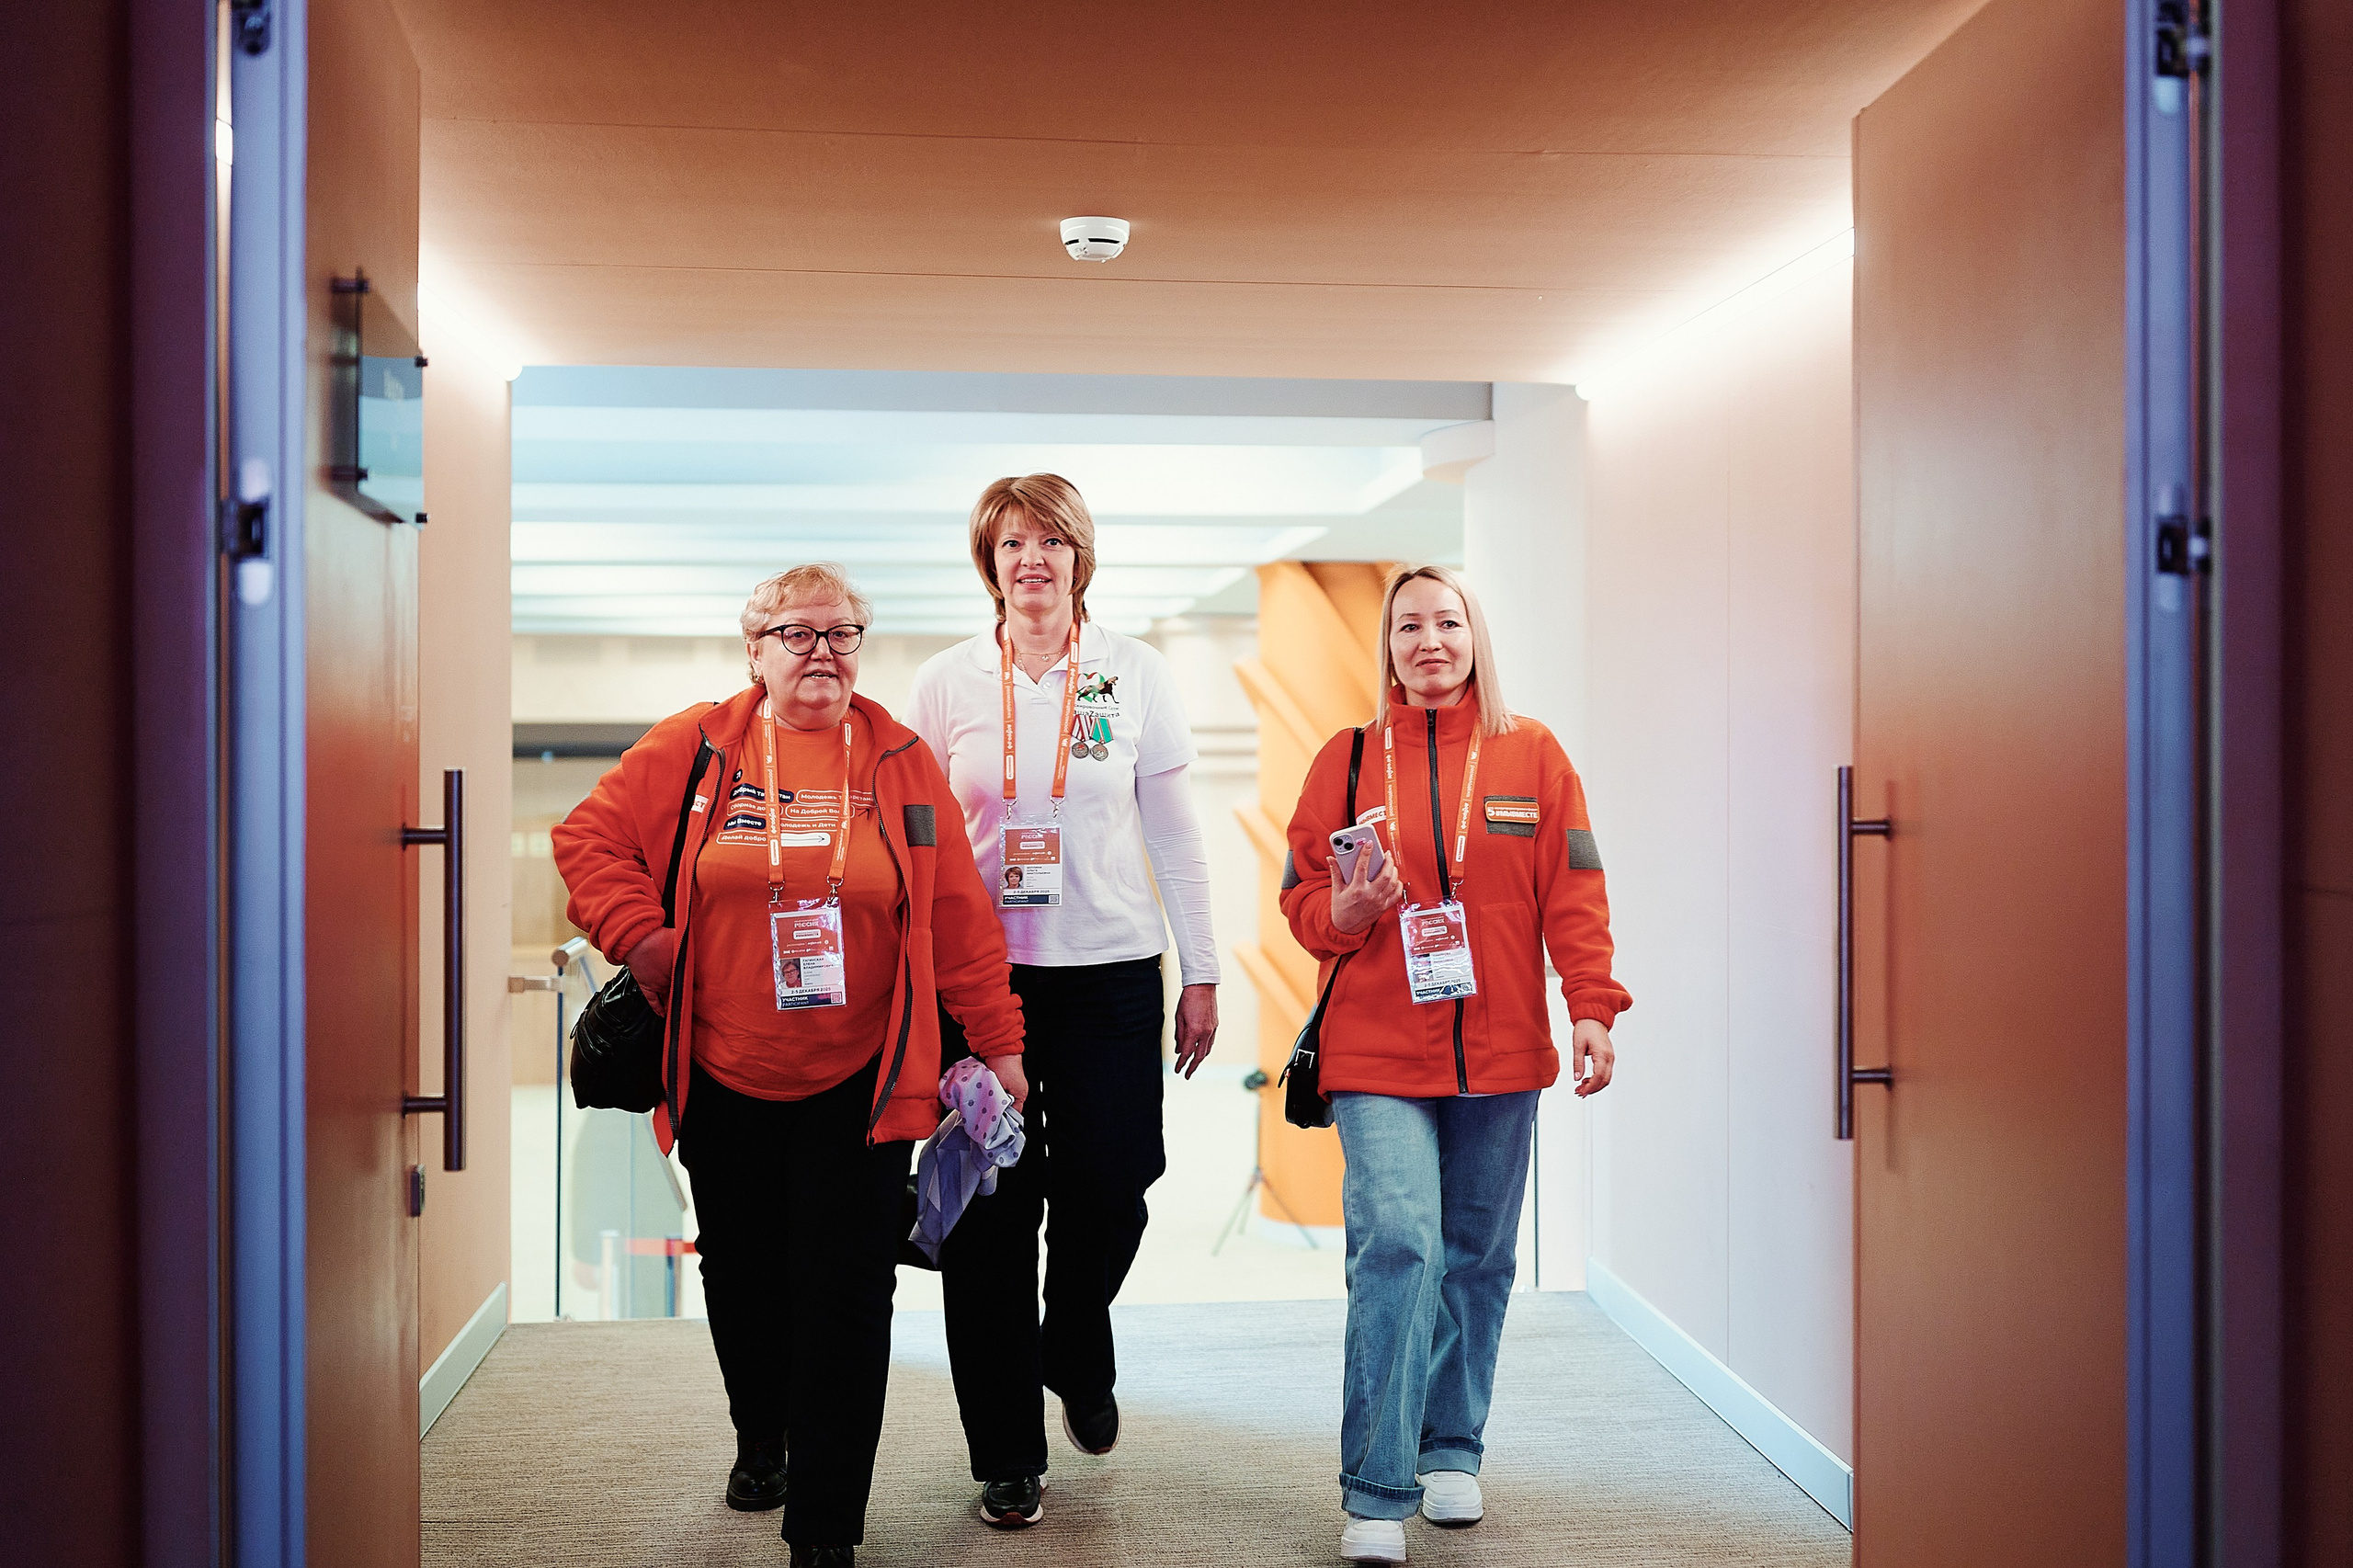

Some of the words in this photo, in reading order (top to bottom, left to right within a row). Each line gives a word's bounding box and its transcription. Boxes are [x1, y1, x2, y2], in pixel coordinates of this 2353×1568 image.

[1487, 806, 1495, 816] 5
[722, 833, 744, 841] Делай
[744, 835, 767, 843] добро
